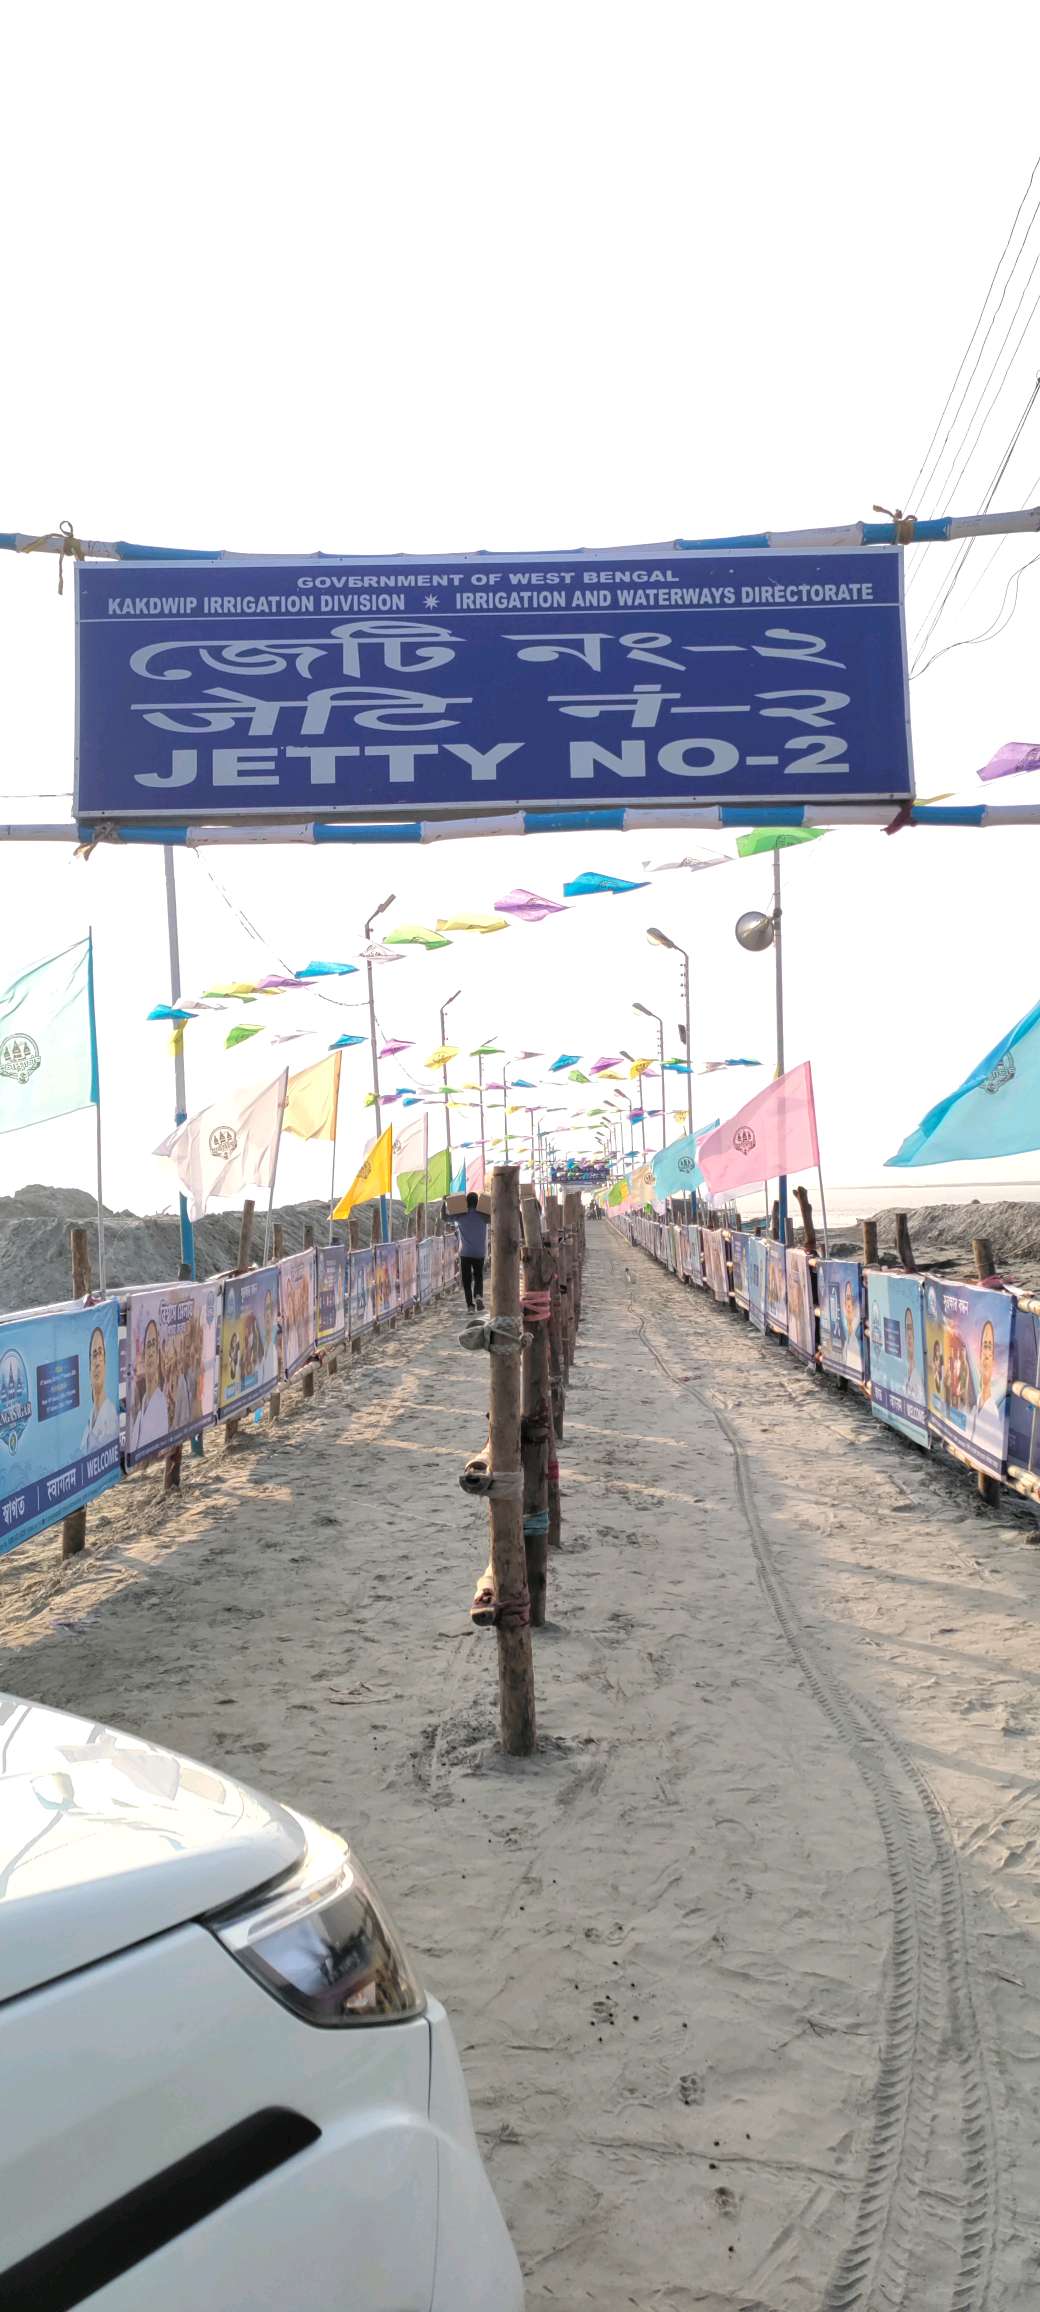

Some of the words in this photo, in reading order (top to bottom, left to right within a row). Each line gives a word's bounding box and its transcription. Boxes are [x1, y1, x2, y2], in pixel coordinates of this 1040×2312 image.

[108, 597, 198, 616] KAKDWIP
[203, 594, 315, 614] IRRIGATION
[320, 593, 406, 612] DIVISION
[456, 591, 566, 611] IRRIGATION
[571, 590, 612, 608] AND
[617, 587, 736, 607] WATERWAYS
[741, 583, 873, 604] DIRECTORATE
[297, 575, 464, 589] GOVERNMENT
[471, 574, 502, 587] OF
[508, 572, 575, 585] WEST
[583, 570, 680, 584] BENGAL
[130, 620, 467, 680] জেটি
[501, 628, 848, 672] নং-২
[130, 686, 473, 736] जेटि
[133, 742, 525, 788] JETTY
[569, 735, 850, 779] NO-2
[86, 1445, 119, 1479] WELCOME
